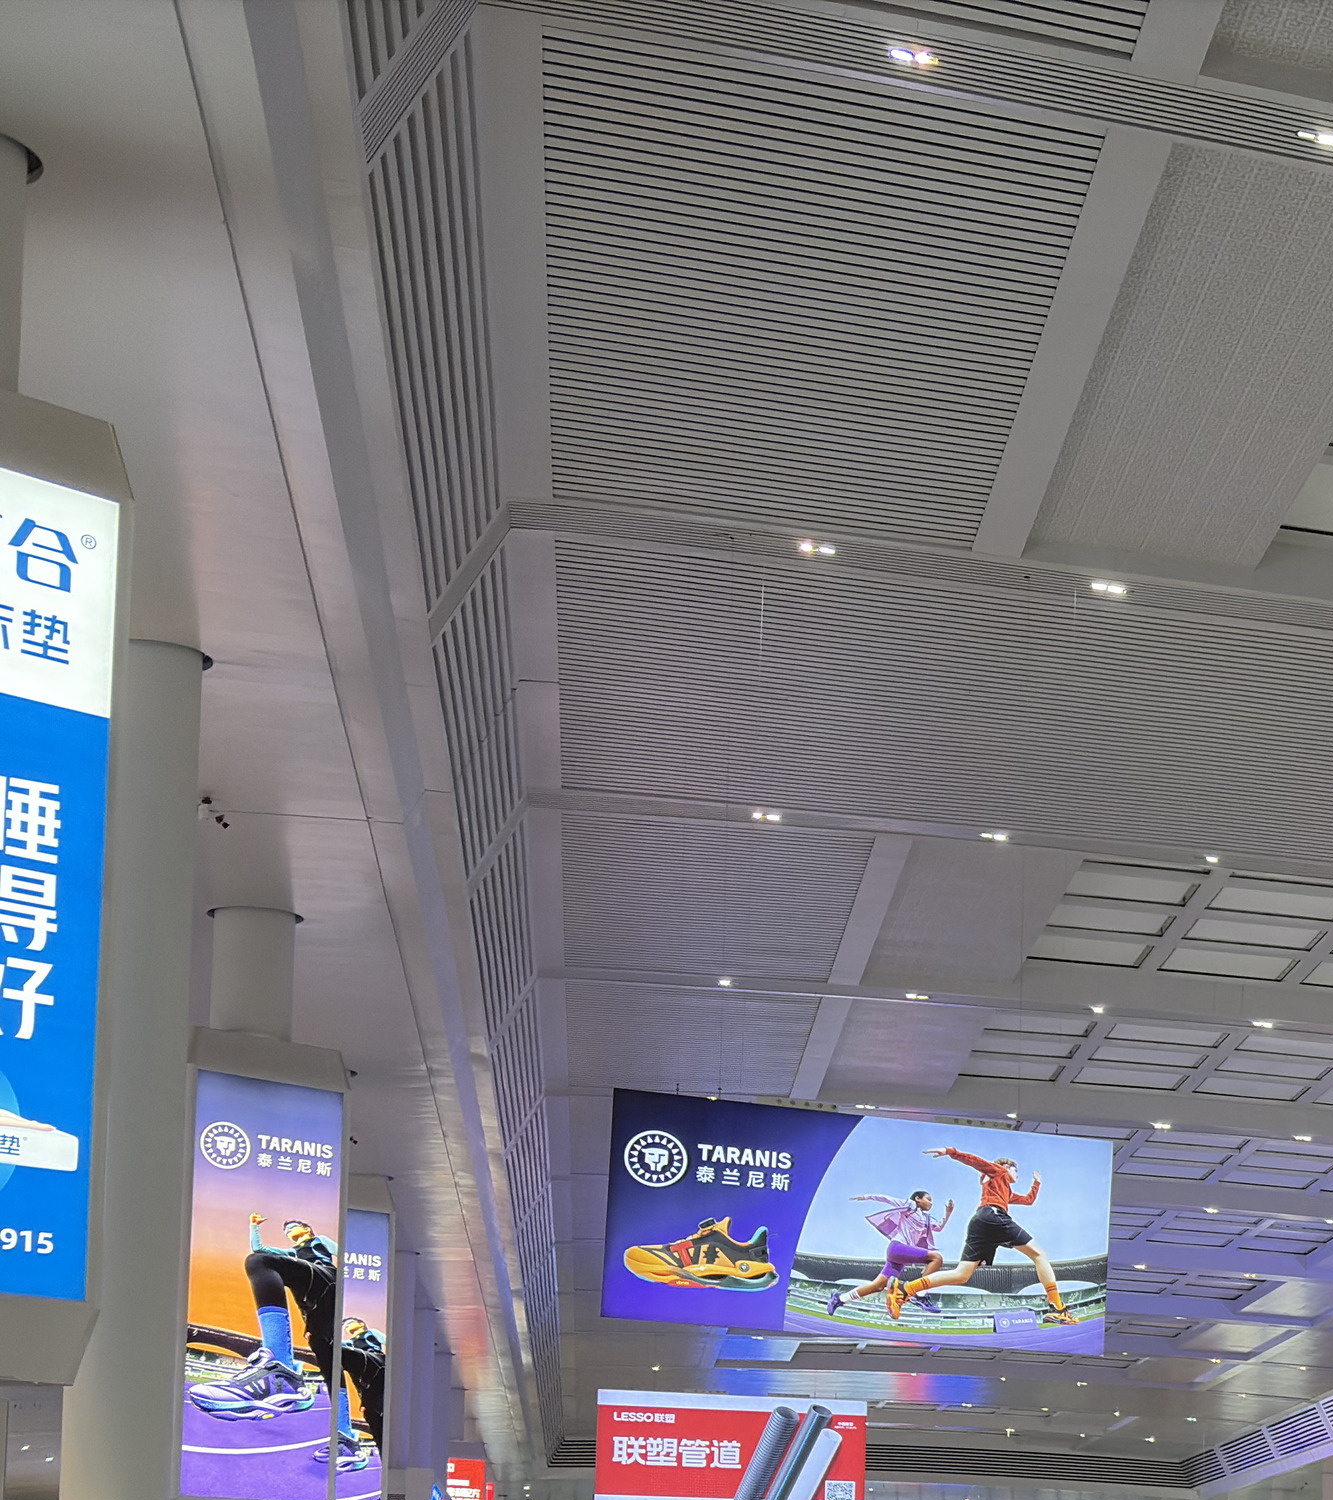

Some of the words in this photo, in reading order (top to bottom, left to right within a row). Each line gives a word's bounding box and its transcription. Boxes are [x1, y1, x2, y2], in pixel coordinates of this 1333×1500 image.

[257, 1134, 334, 1159] TARANIS
[697, 1143, 793, 1170] TARANIS
[256, 1153, 333, 1177] 泰兰尼斯
[695, 1166, 791, 1191] 泰兰尼斯
[343, 1252, 382, 1267] RANIS
[343, 1268, 381, 1282] 兰尼斯
[612, 1436, 742, 1469] 联塑管道
